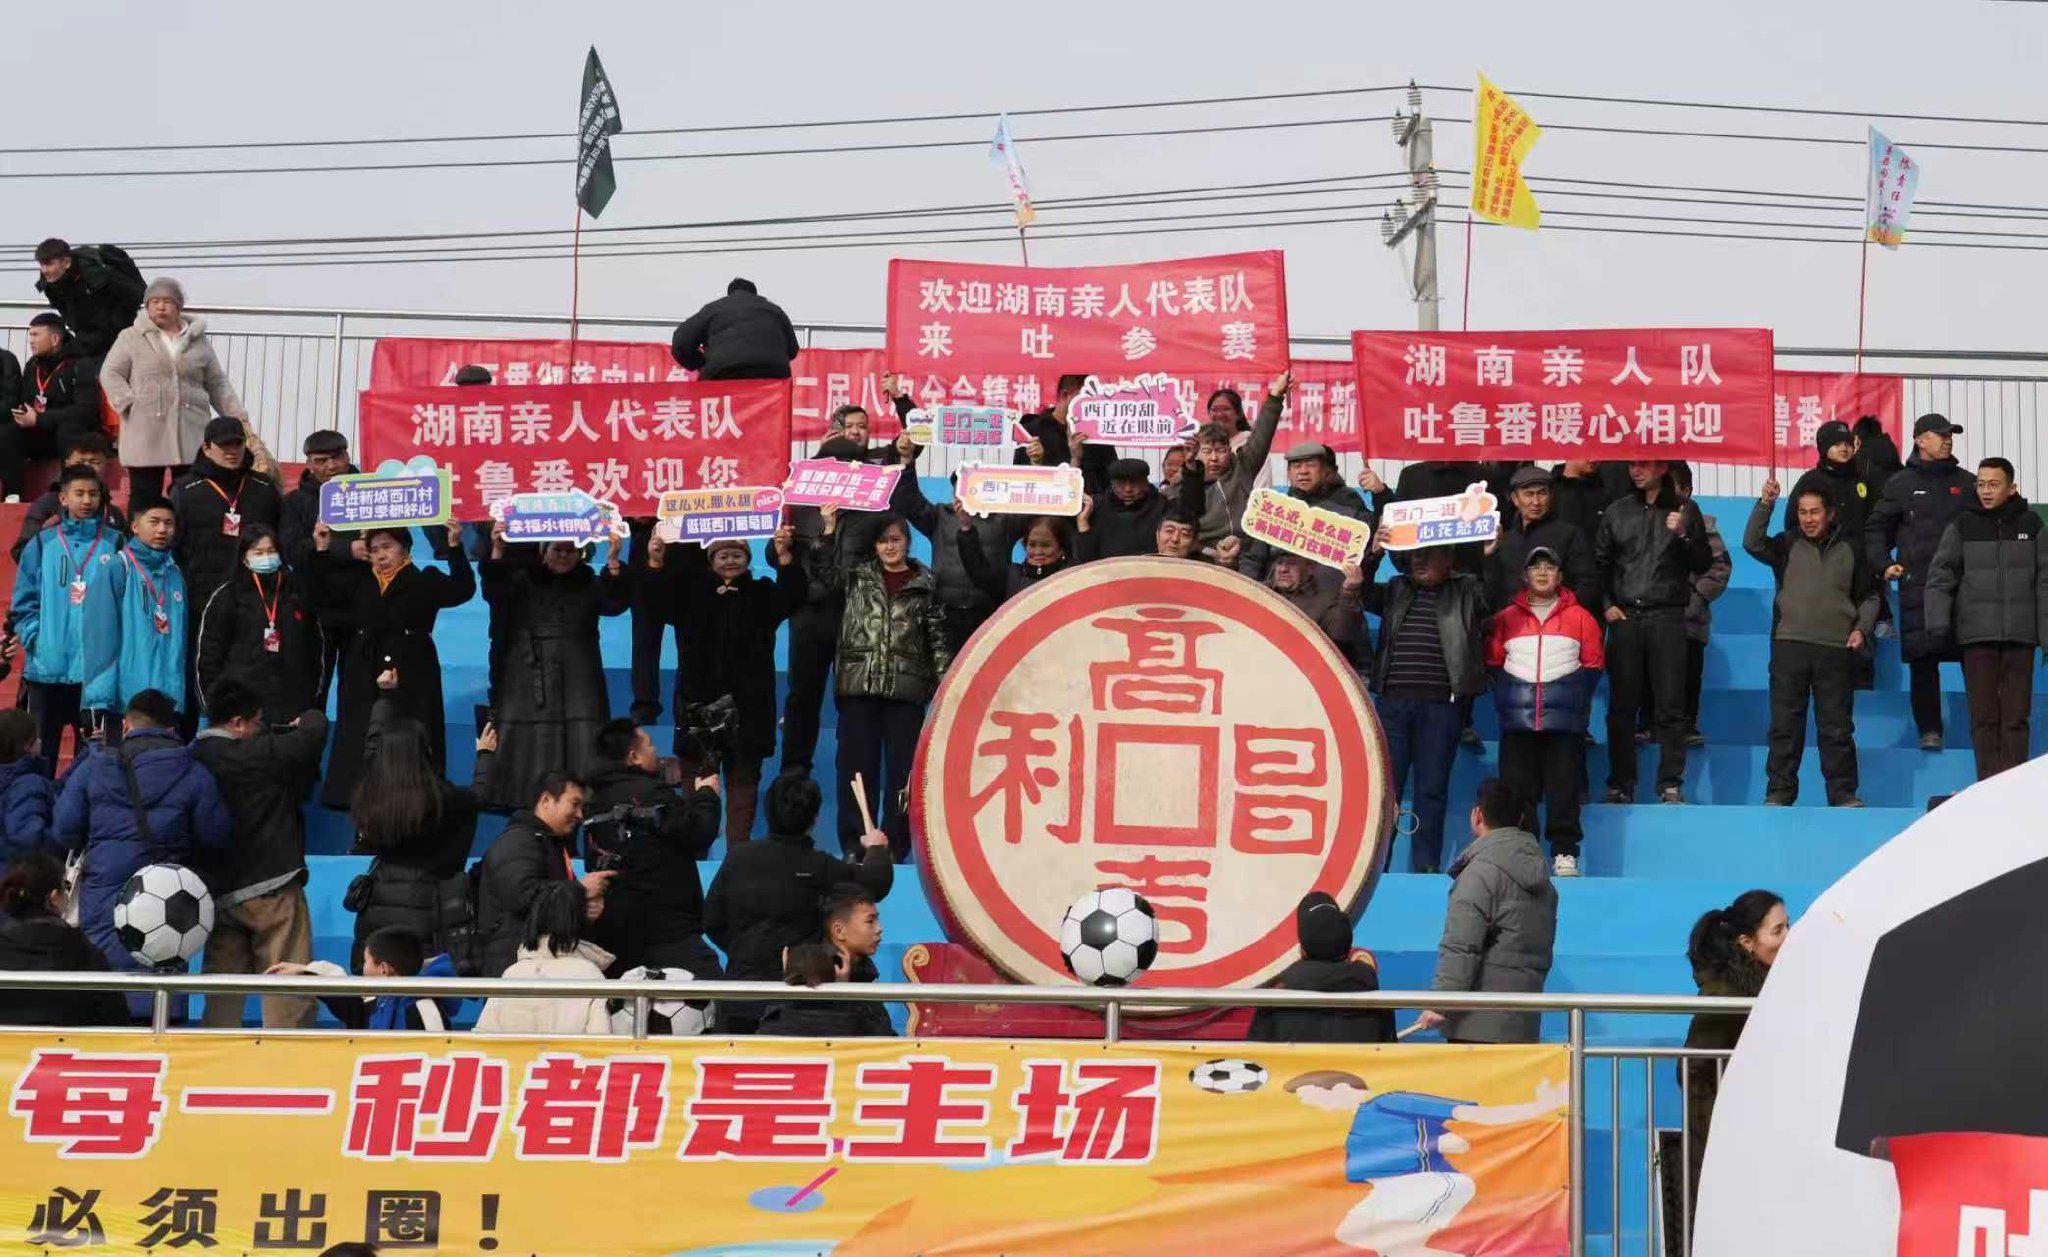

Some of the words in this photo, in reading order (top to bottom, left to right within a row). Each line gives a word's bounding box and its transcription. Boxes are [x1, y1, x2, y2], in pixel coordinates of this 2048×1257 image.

[919, 272, 1256, 318] 欢迎湖南亲人代表队
[918, 321, 1257, 361] 来吐参赛
[1405, 344, 1724, 387] 湖南亲人队
[411, 395, 743, 447] 湖南亲人代表队
[1084, 402, 1156, 417] 西门的甜
[1101, 419, 1173, 434] 近在眼前
[1404, 401, 1725, 447] 吐鲁番暖心相迎
[330, 486, 433, 507] 走进新城西门村
[11, 1050, 1162, 1162] 每一秒都是主场
